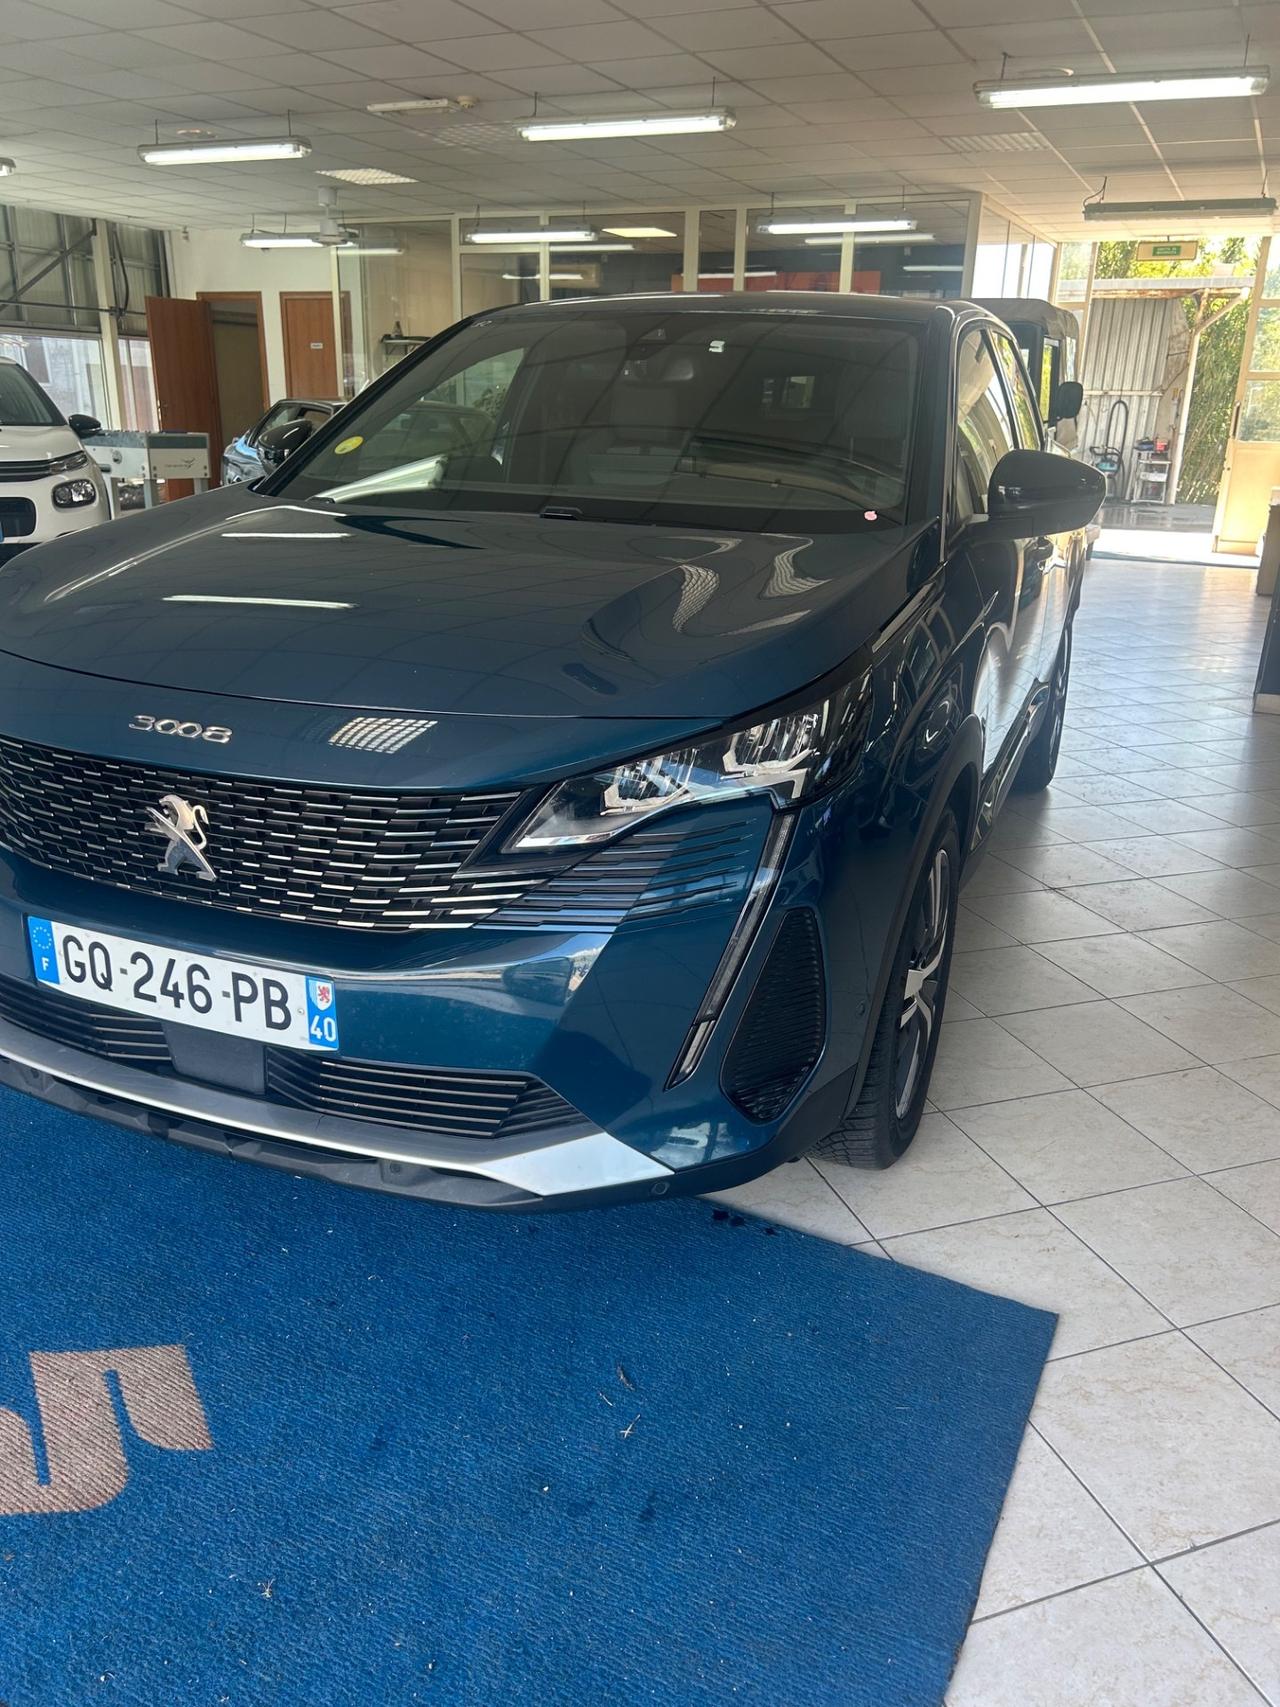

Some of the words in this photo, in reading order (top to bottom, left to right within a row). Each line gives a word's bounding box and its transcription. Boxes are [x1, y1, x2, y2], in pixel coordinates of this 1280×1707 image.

[128, 714, 233, 744] 3008
[41, 956, 50, 972] F
[62, 934, 292, 1031] GQ-246-PB
[310, 1015, 337, 1042] 40
